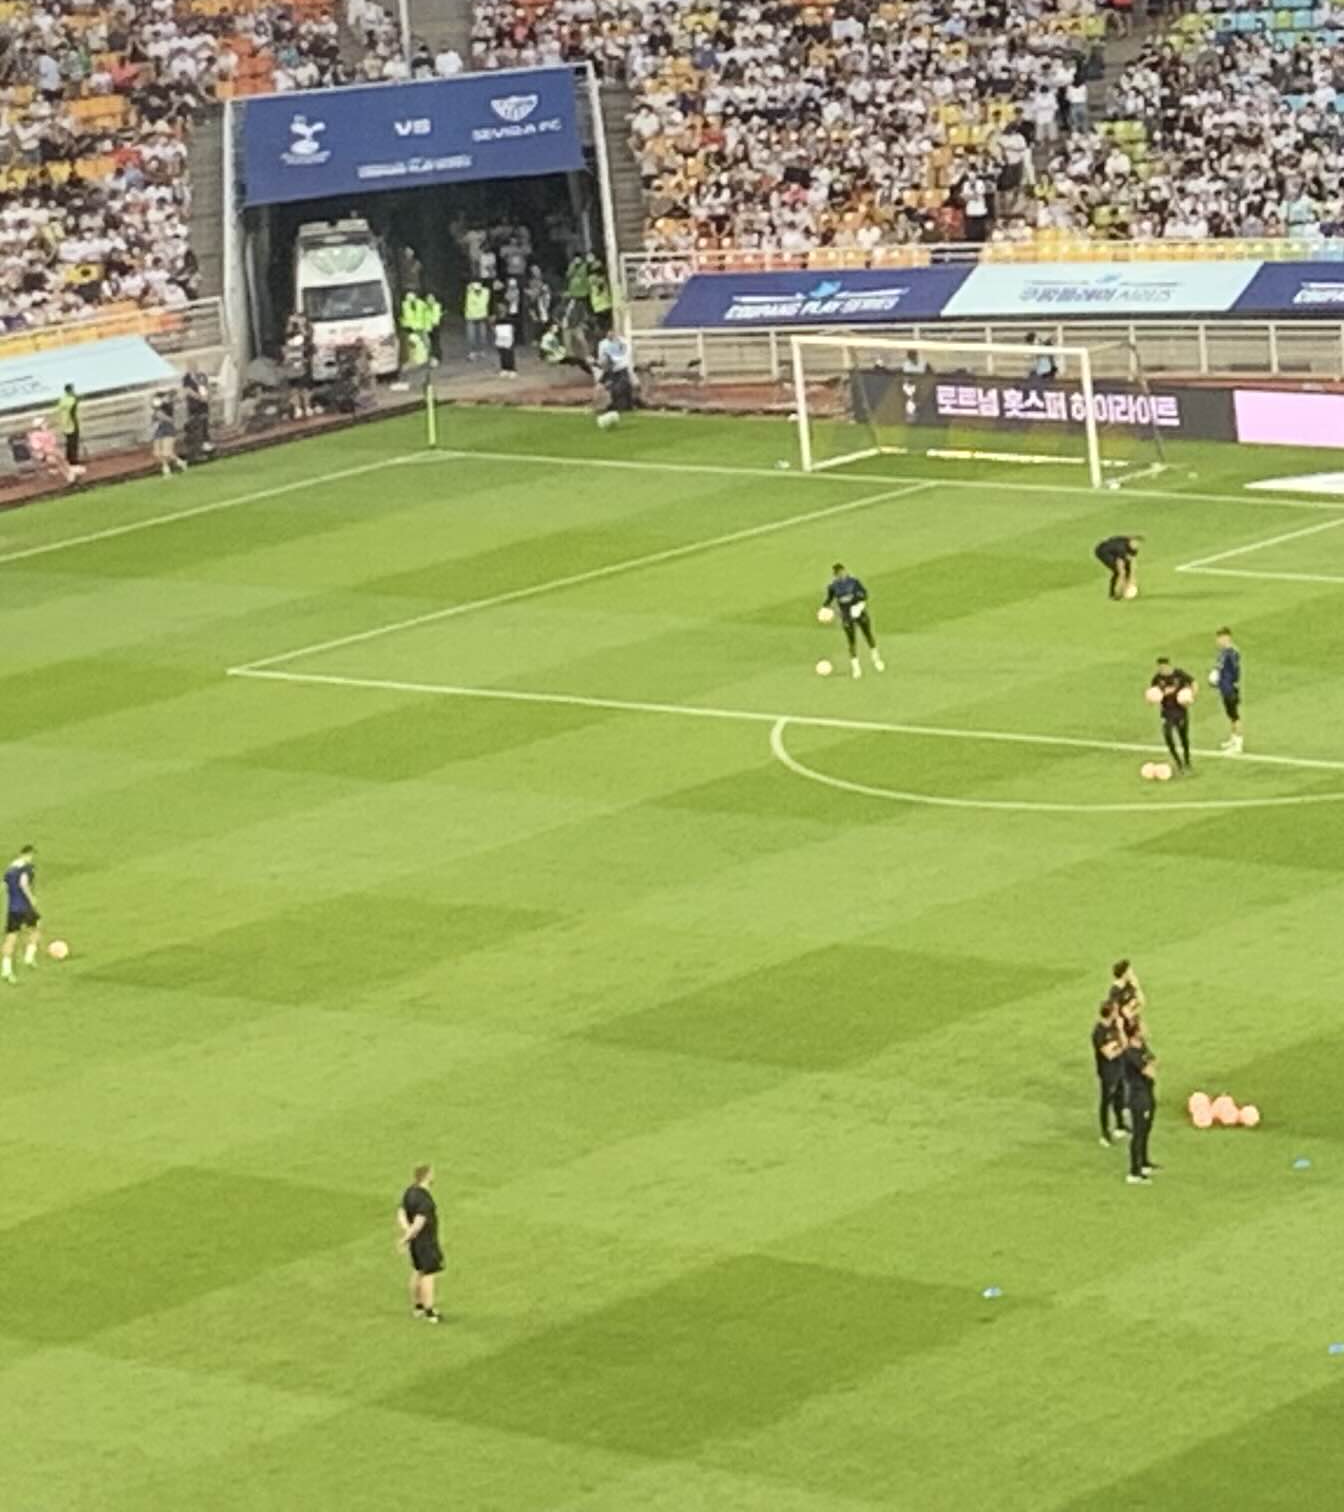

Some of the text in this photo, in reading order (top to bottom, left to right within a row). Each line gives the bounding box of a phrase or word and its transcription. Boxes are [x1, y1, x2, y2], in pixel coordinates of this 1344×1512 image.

[394, 118, 431, 136] VS
[936, 385, 999, 416] 토트넘
[1070, 390, 1181, 427] 하이라이트
